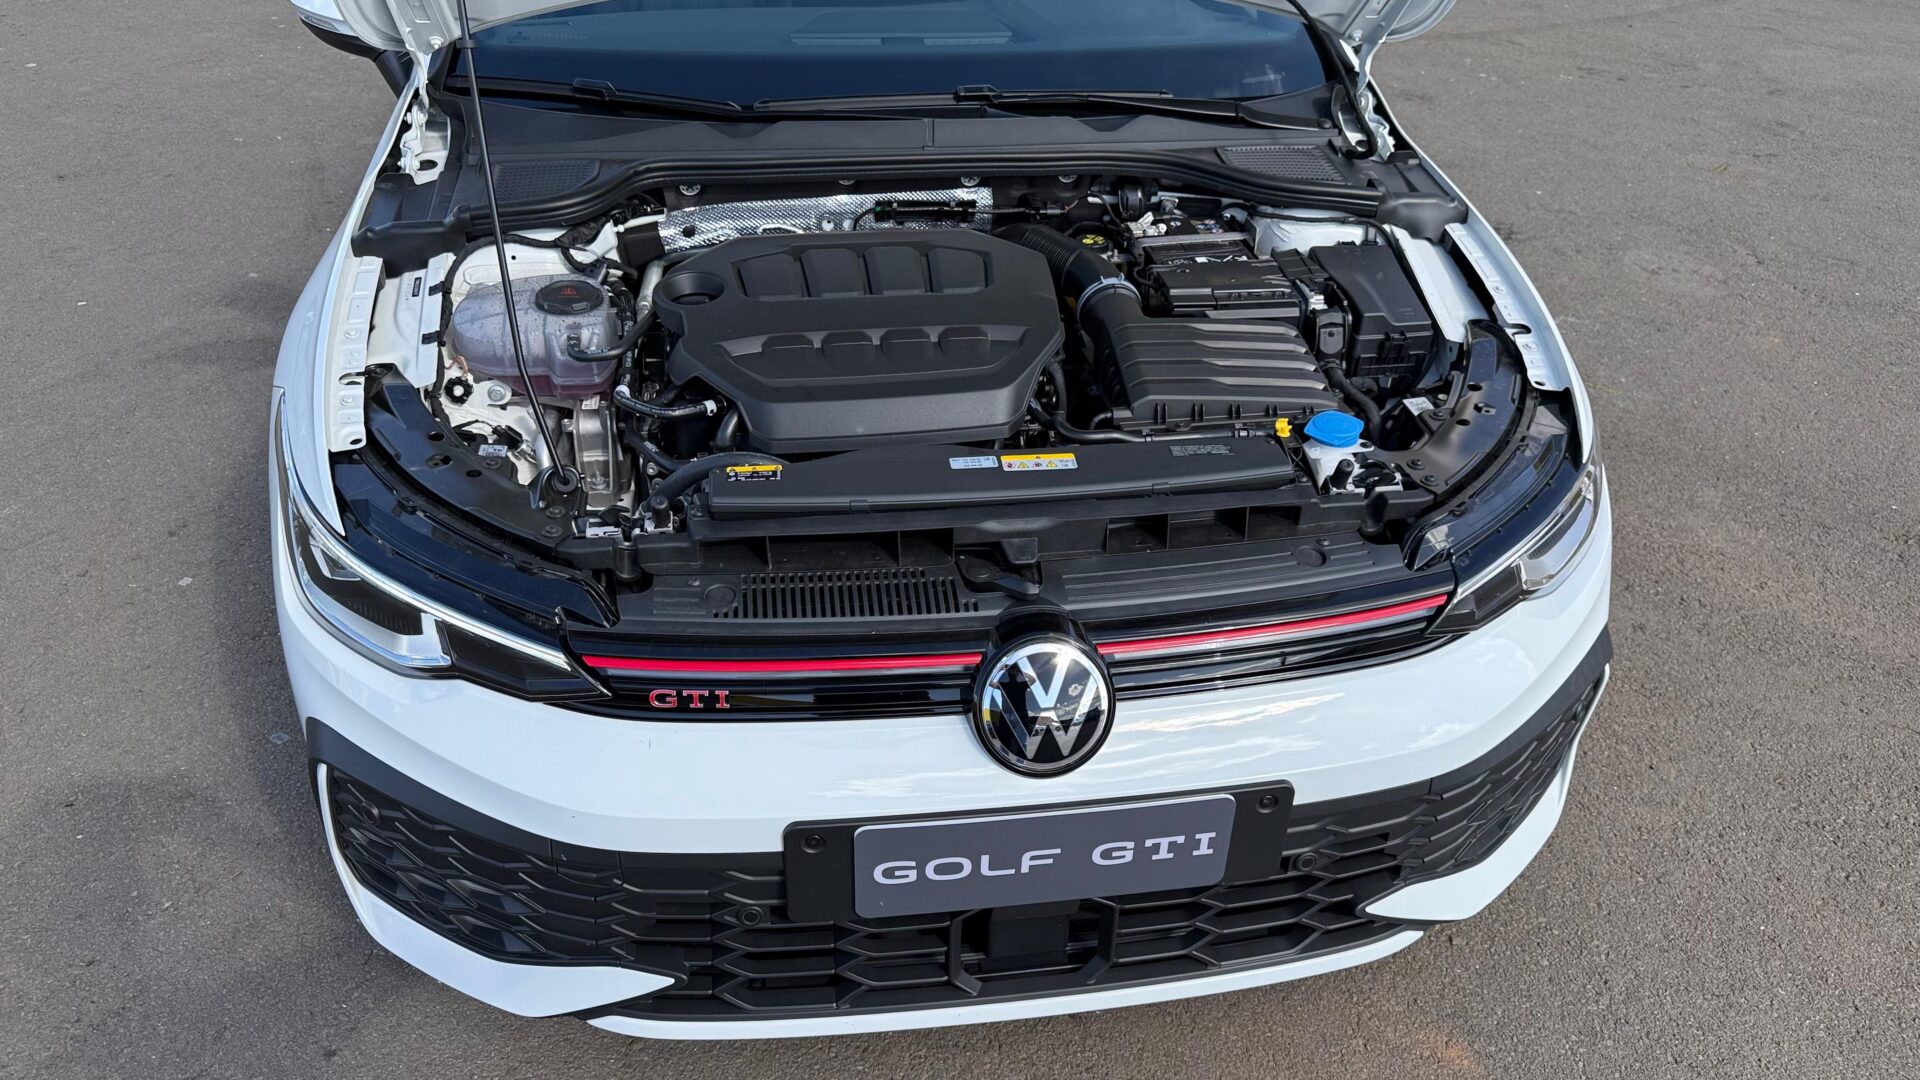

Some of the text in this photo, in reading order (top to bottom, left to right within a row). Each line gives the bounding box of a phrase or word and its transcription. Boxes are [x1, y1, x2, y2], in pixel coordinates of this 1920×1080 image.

[649, 689, 731, 709] GTI
[873, 831, 1218, 886] GOLF GTI
